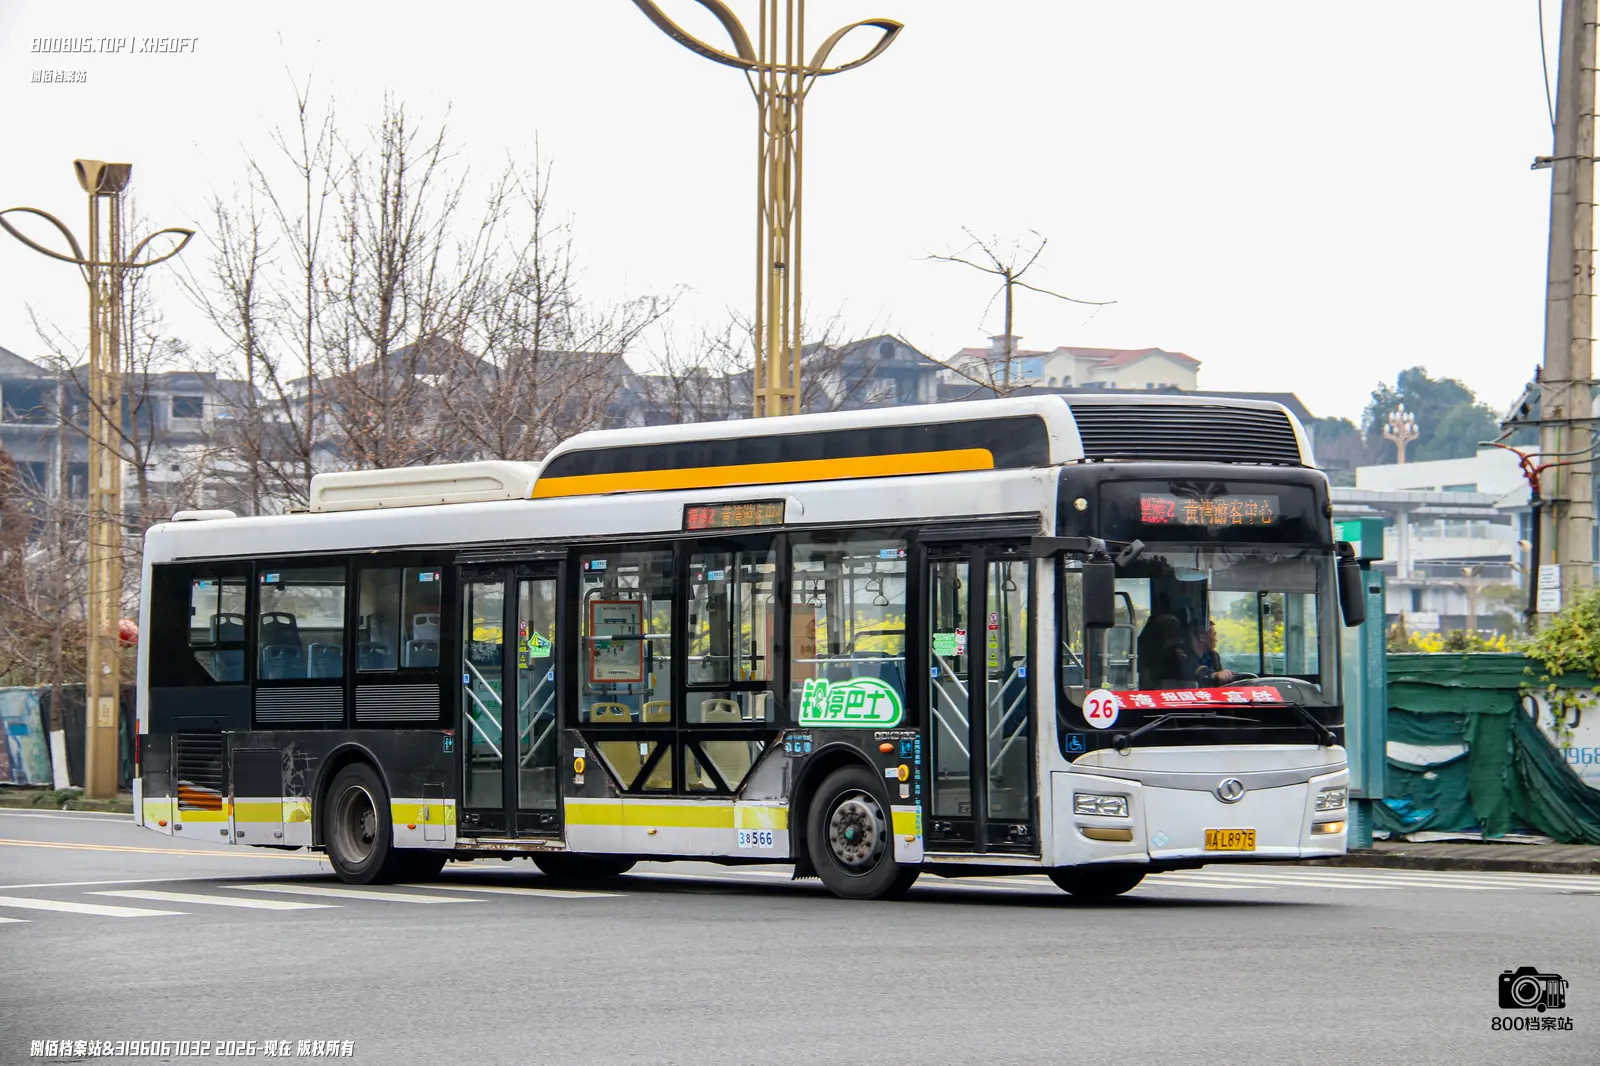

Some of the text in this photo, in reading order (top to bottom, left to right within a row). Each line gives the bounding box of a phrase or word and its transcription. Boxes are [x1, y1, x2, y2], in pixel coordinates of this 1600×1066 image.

[1183, 498, 1273, 525] 黄湾游客中心
[1160, 691, 1213, 702] 报国寺
[1089, 699, 1113, 719] 26
[739, 832, 773, 846] 38566
